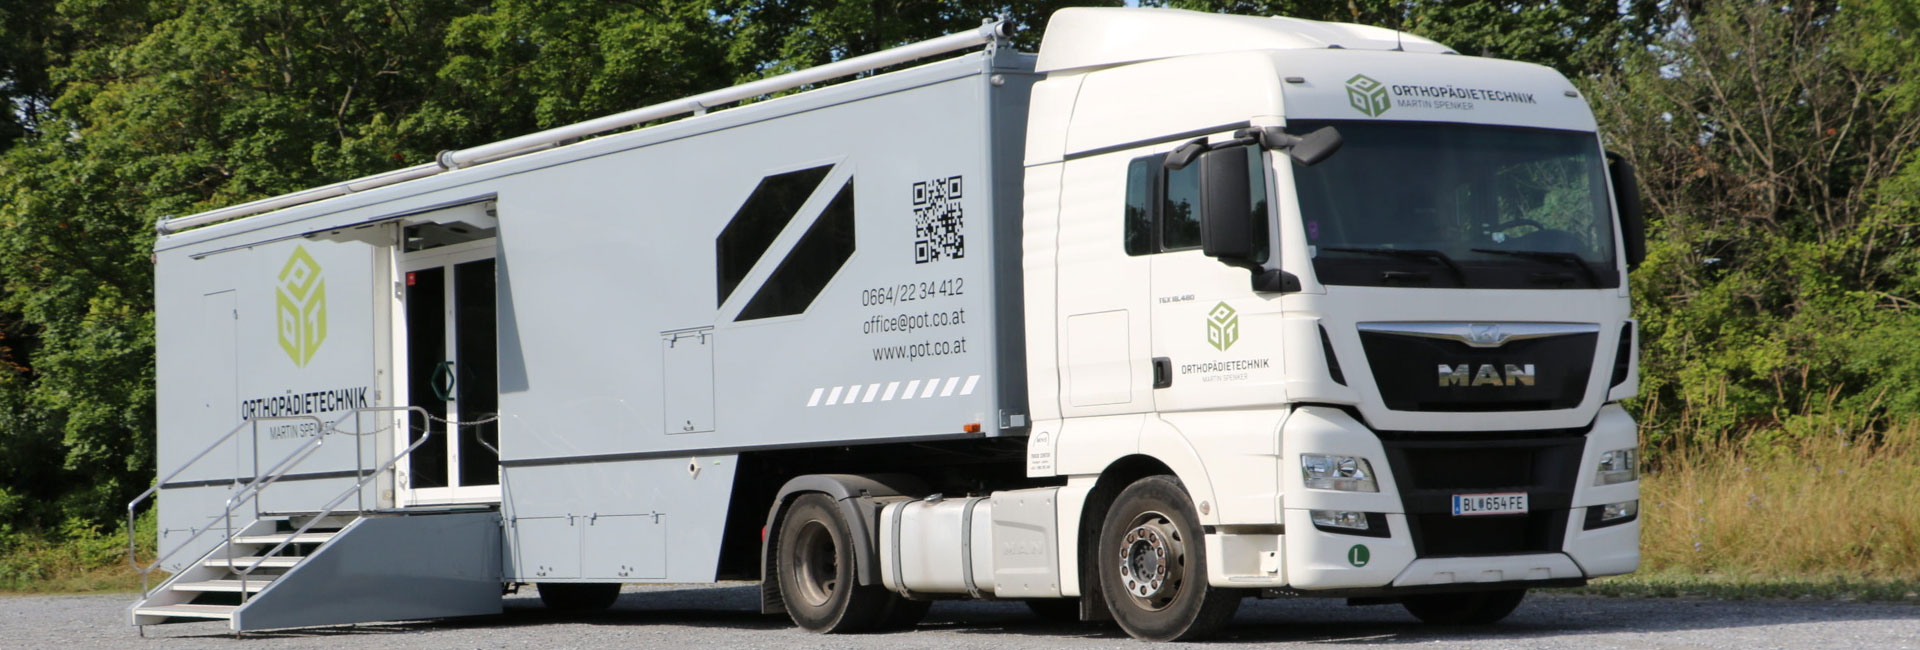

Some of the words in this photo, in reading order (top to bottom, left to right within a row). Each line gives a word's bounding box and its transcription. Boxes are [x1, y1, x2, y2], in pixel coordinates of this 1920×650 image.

[1391, 84, 1537, 104] ORTHOPÄDIETECHNIK
[1397, 99, 1432, 109] MARTIN
[1433, 100, 1475, 110] SPENKER
[862, 283, 916, 307] 0664/22
[919, 281, 935, 300] 34
[939, 277, 964, 297] 412
[863, 307, 966, 335] office@pot.co.at
[872, 336, 967, 362] www.pot.co.at
[1181, 358, 1270, 375] ORTHOPÄDIETECHNIK
[1438, 364, 1535, 386] MAN
[1202, 374, 1222, 383] MARTIN
[1222, 373, 1248, 382] SPENKER
[242, 386, 368, 420] ORTHOPÄDIETECHNIK
[269, 425, 299, 440] MARTIN
[299, 421, 337, 438] SPENER
[1463, 498, 1477, 511] BL
[1354, 548, 1365, 565] L
